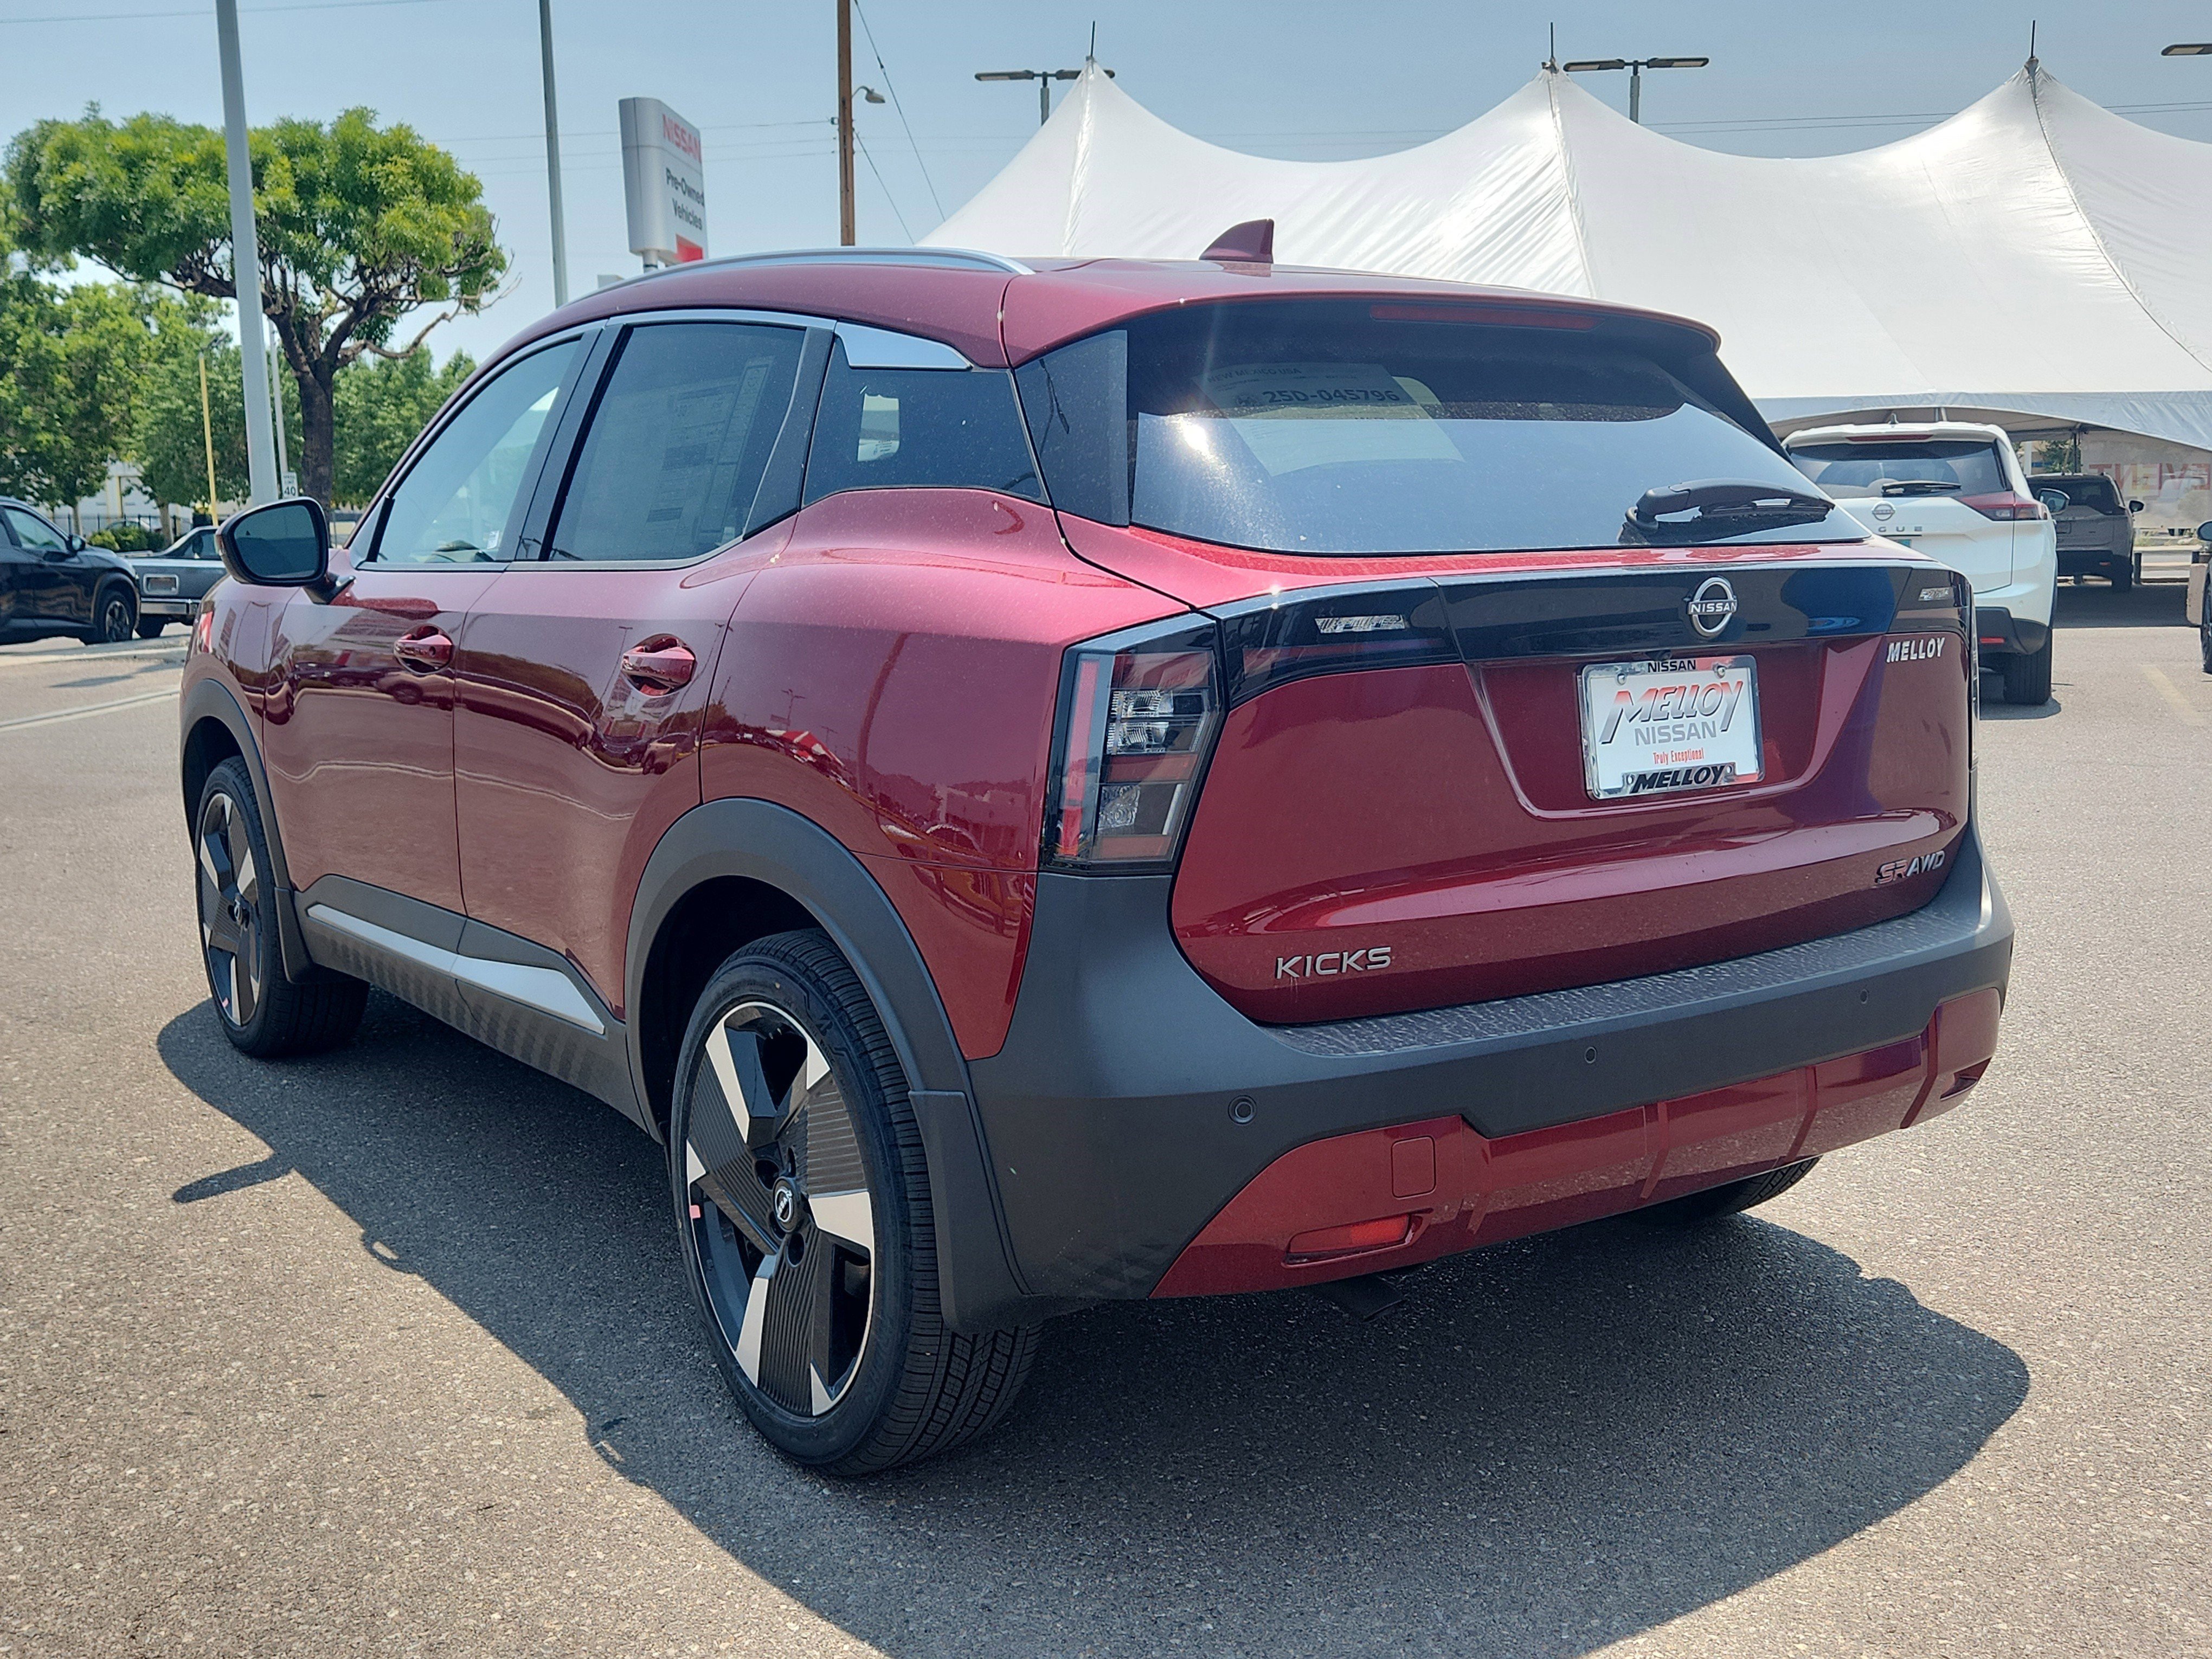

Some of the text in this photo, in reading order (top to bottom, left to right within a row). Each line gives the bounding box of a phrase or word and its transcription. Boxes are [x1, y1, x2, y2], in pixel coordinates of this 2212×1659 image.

[663, 114, 702, 163] NISSAN
[665, 167, 705, 207] Pre-Owned
[672, 197, 703, 230] Vehicles
[1236, 367, 1276, 377] MEXICO
[1278, 367, 1302, 375] USA
[1262, 389, 1400, 404] 25D-045796
[284, 486, 296, 496] 40
[1690, 602, 1737, 613] NISSAN
[1886, 636, 1945, 663] MELLOY
[1648, 660, 1696, 673] NISSAN
[1599, 679, 1744, 745] MELLOY
[1635, 721, 1717, 746] NISSAN
[1653, 747, 1705, 766] Truly Exceptional
[1629, 765, 1726, 794] MELLOY
[1276, 946, 1391, 980] KICKS
